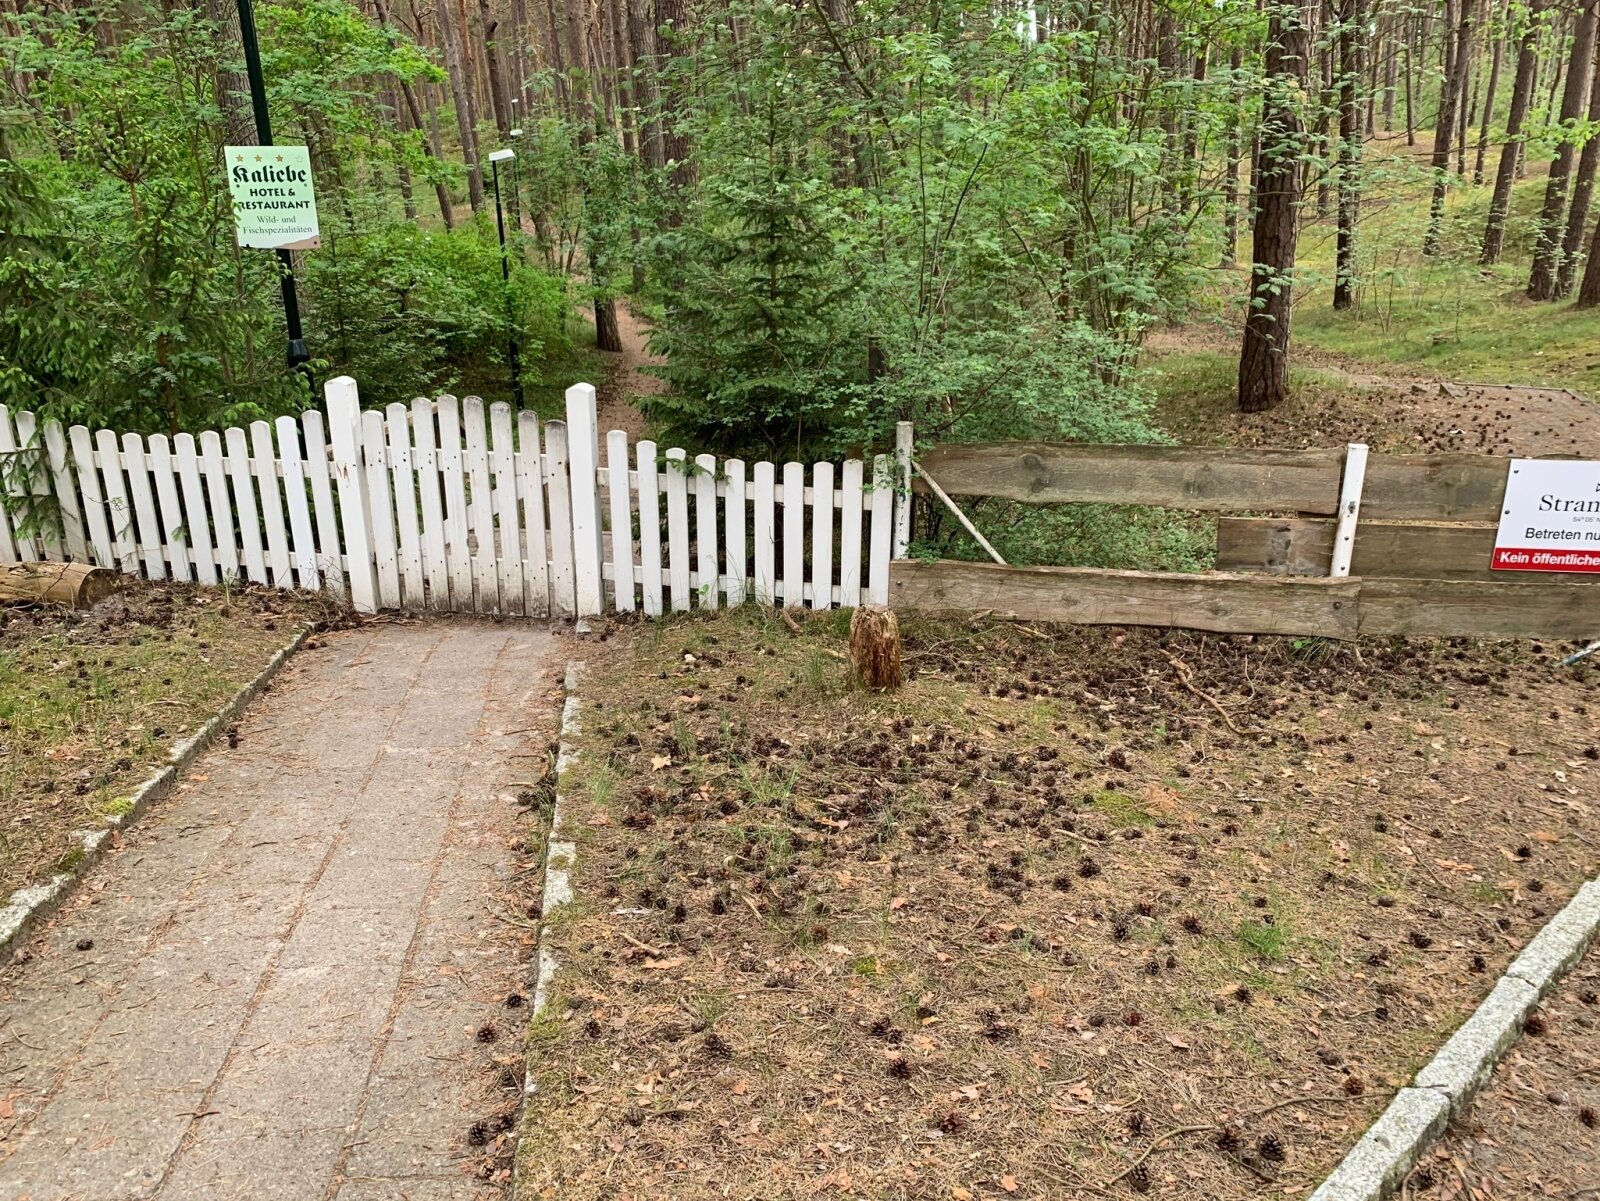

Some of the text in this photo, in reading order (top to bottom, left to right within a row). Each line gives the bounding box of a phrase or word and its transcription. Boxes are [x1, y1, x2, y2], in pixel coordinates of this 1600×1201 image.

[232, 165, 307, 183] Kaliebe
[250, 188, 286, 196] HOTEL
[238, 201, 310, 209] RESTAURANT
[243, 226, 312, 235] Fischspezialitäten
[1525, 527, 1581, 540] Betreten
[1500, 552, 1529, 563] Kein
